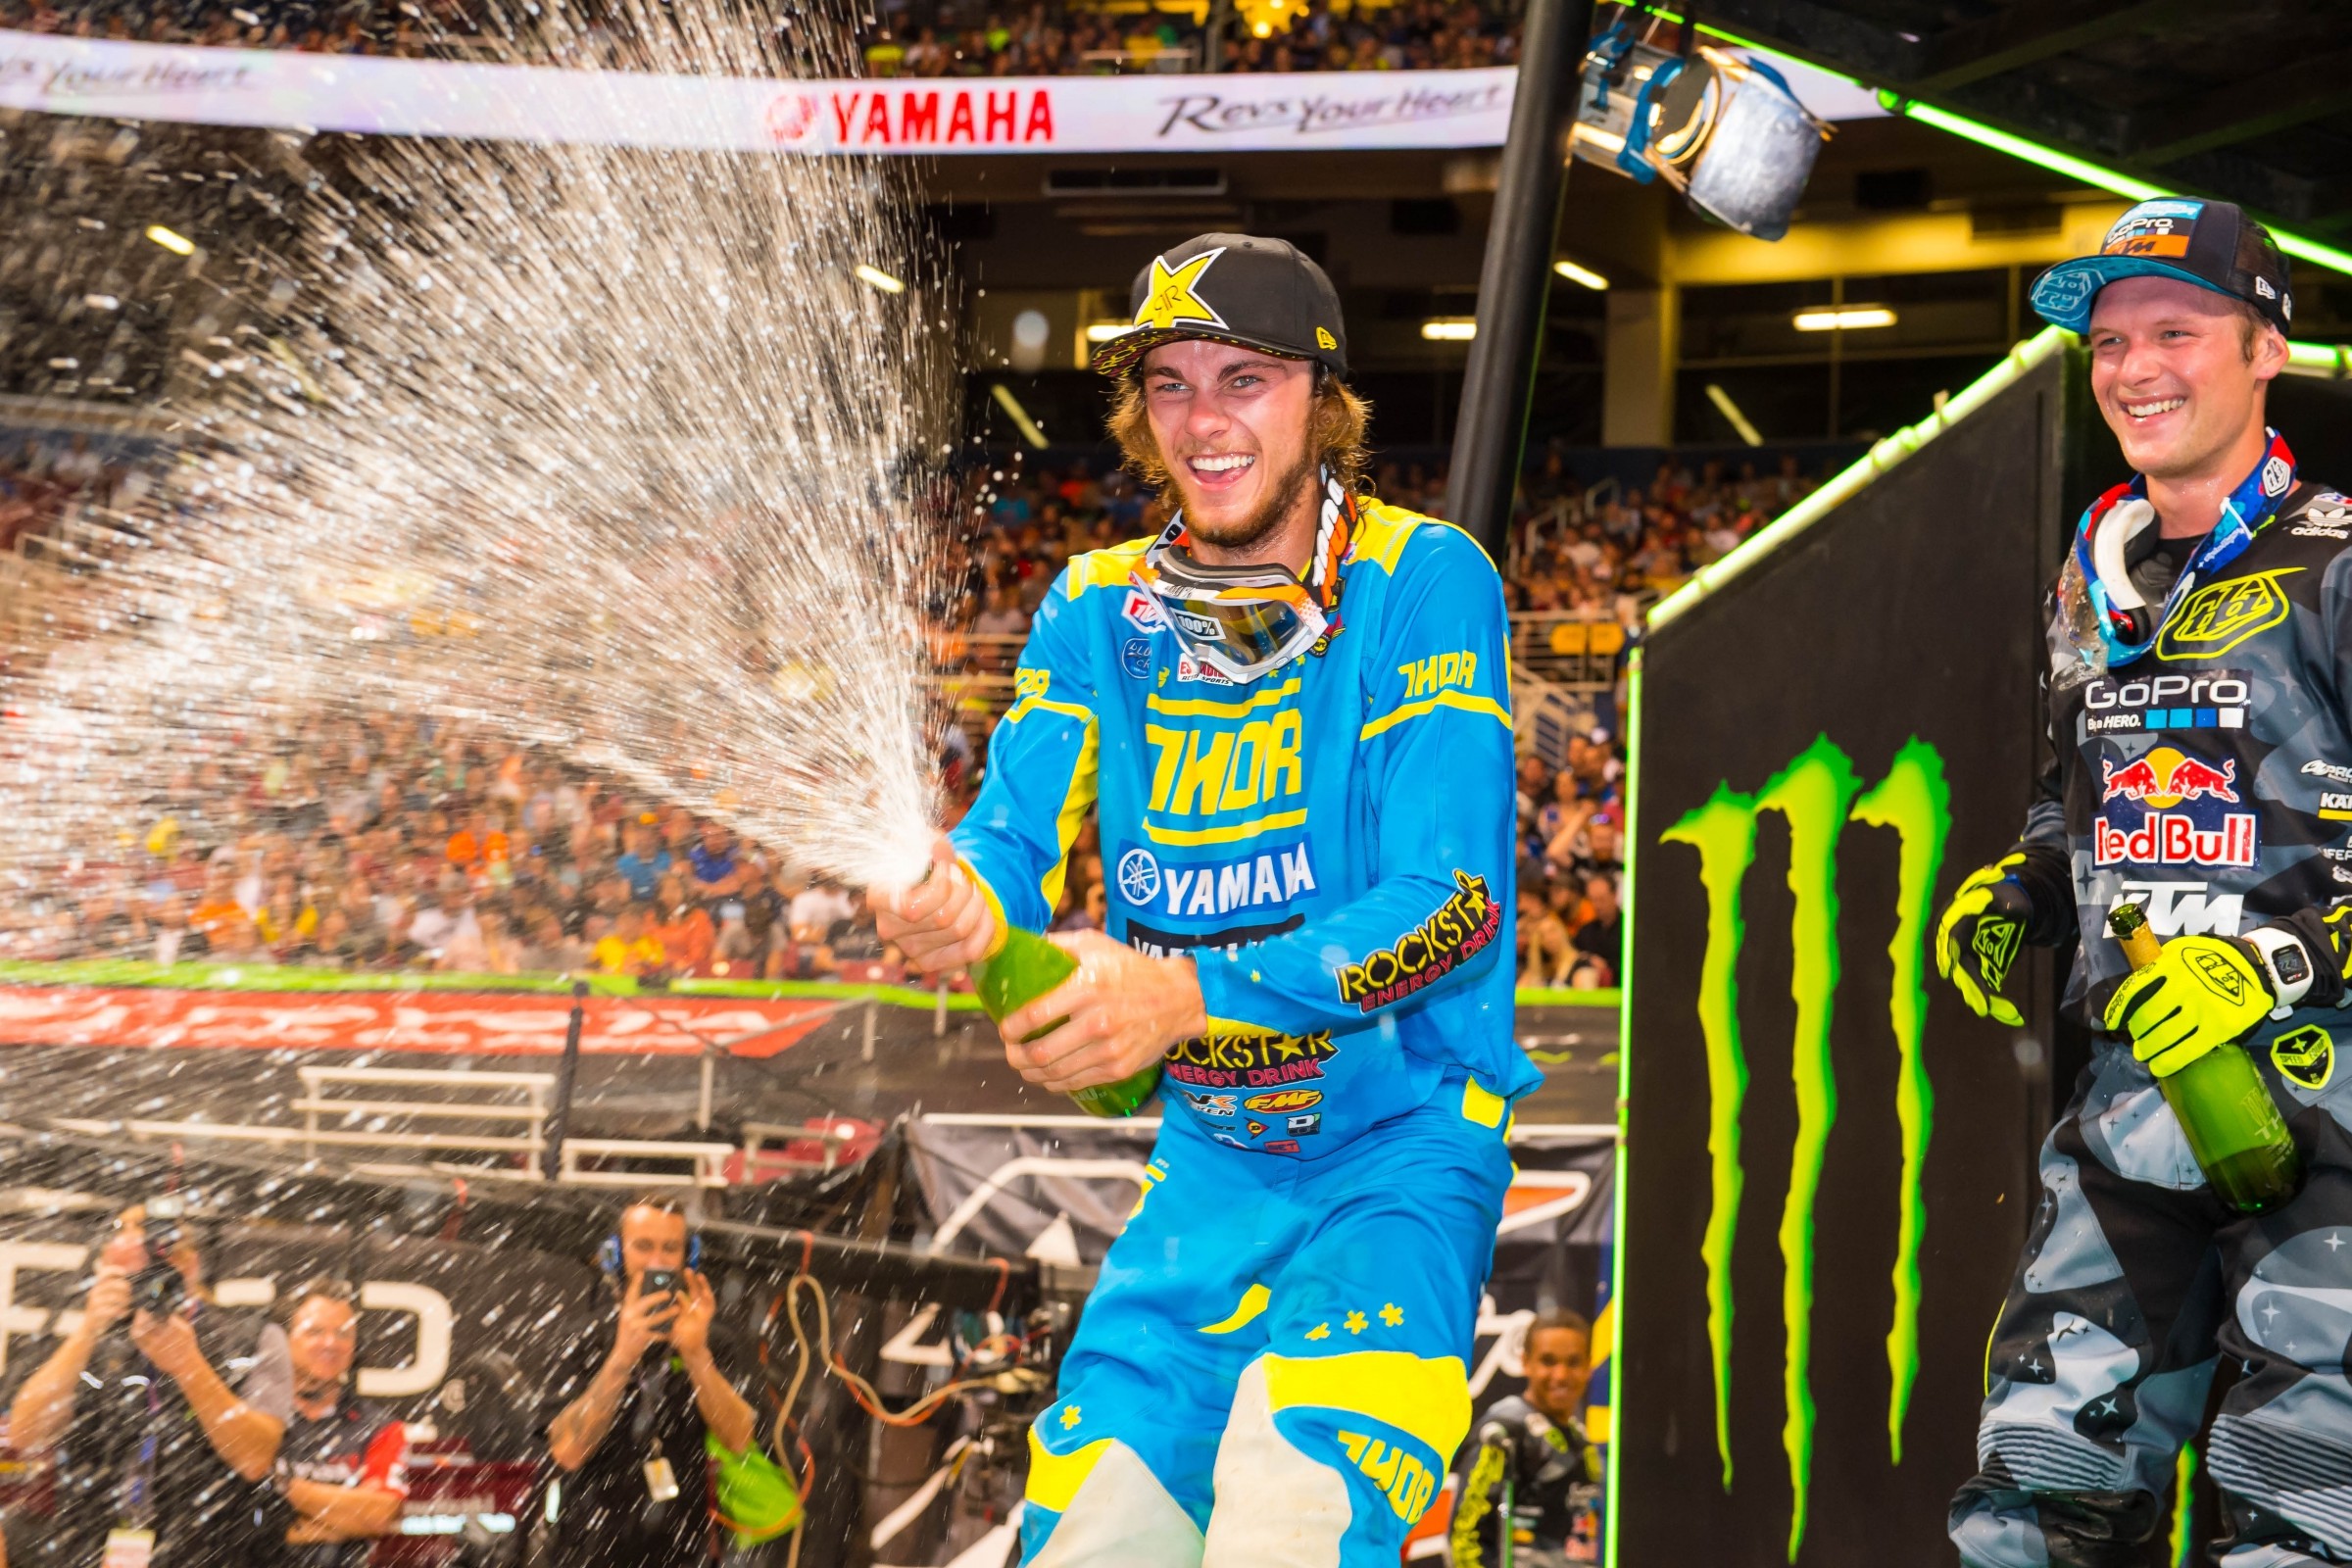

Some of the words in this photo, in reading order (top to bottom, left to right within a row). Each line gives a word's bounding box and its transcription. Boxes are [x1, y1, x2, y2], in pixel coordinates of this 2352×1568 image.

[830, 90, 1054, 143] YAMAHA
[1156, 94, 1290, 136] Revs
[1295, 92, 1388, 133] Your
[1394, 83, 1503, 119] Heart
[2291, 526, 2350, 540] adidas
[1178, 614, 1216, 636] 100%
[1201, 675, 1231, 686] SPORTS
[1397, 650, 1478, 699] THOR
[2085, 675, 2248, 710] GoPro
[1145, 709, 1302, 815] THOR
[2165, 816, 2253, 863] Bull
[2102, 880, 2245, 939] KTM
[1361, 953, 1452, 1012] ENERGY
[1459, 895, 1500, 960] DRINK
[1163, 1028, 1336, 1070] OCKSTAR
[1166, 1063, 1238, 1087] NERGY
[1247, 1057, 1324, 1086] DRINK
[1247, 1090, 1321, 1110] FMF
